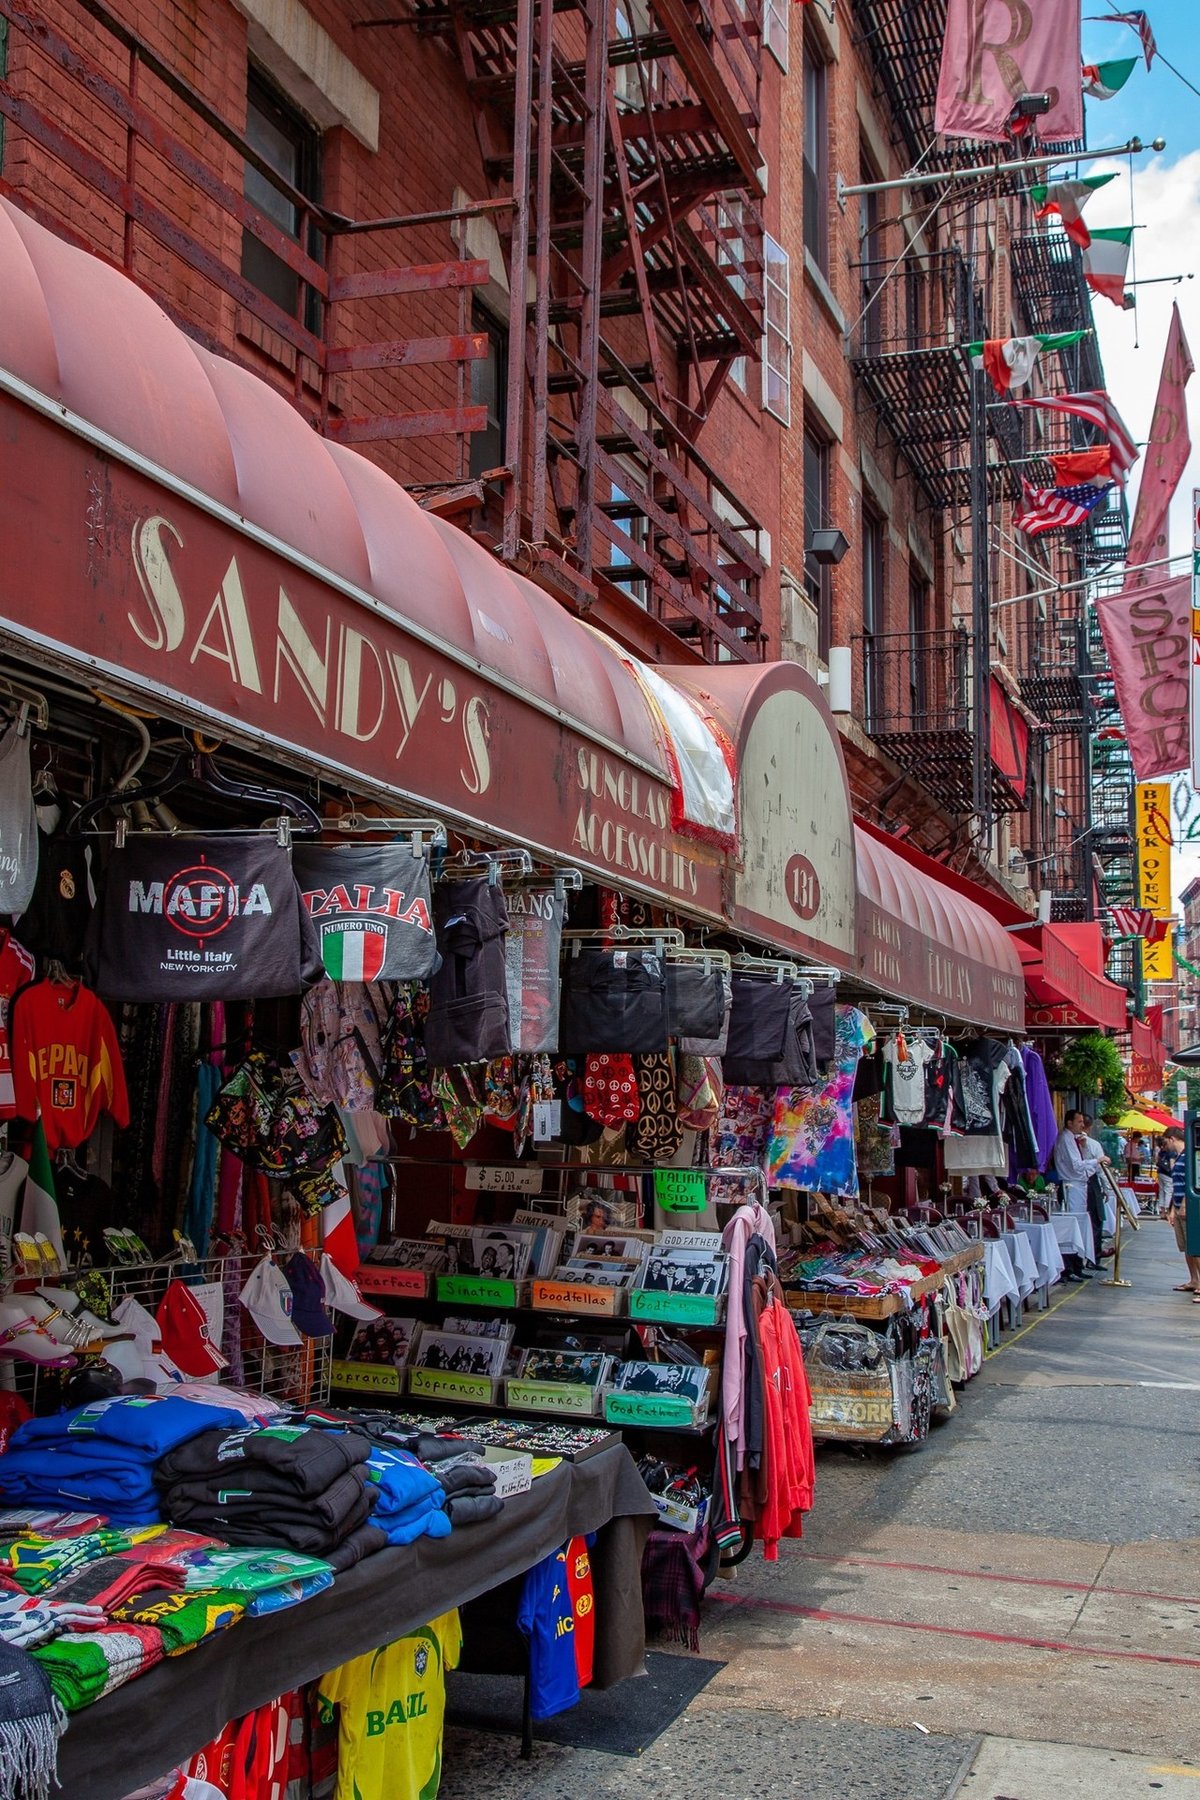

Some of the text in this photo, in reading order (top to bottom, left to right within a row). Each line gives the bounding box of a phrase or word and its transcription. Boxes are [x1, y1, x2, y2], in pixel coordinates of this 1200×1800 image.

[127, 515, 492, 795] SANDY'S
[1143, 790, 1161, 848] BRICK
[792, 866, 814, 910] 131
[1143, 859, 1161, 904] OVEN
[128, 880, 273, 917] MAFIA
[302, 884, 433, 935] TALIA
[324, 922, 383, 935] NUMERO UNO
[167, 949, 232, 963] Little Italy
[160, 962, 237, 973] NEW YORK CITY
[494, 1171, 515, 1183] 5.00
[655, 1171, 704, 1185] ITALIAN
[657, 1192, 697, 1203] INSIDE
[667, 1184, 688, 1193] CD
[515, 1214, 555, 1229] SINATRA
[355, 1271, 422, 1289] Scarface
[446, 1281, 502, 1299] Sinatra
[539, 1287, 607, 1307] Goodfellas
[414, 1371, 485, 1397] Sopranos
[512, 1386, 584, 1409] Sopranos
